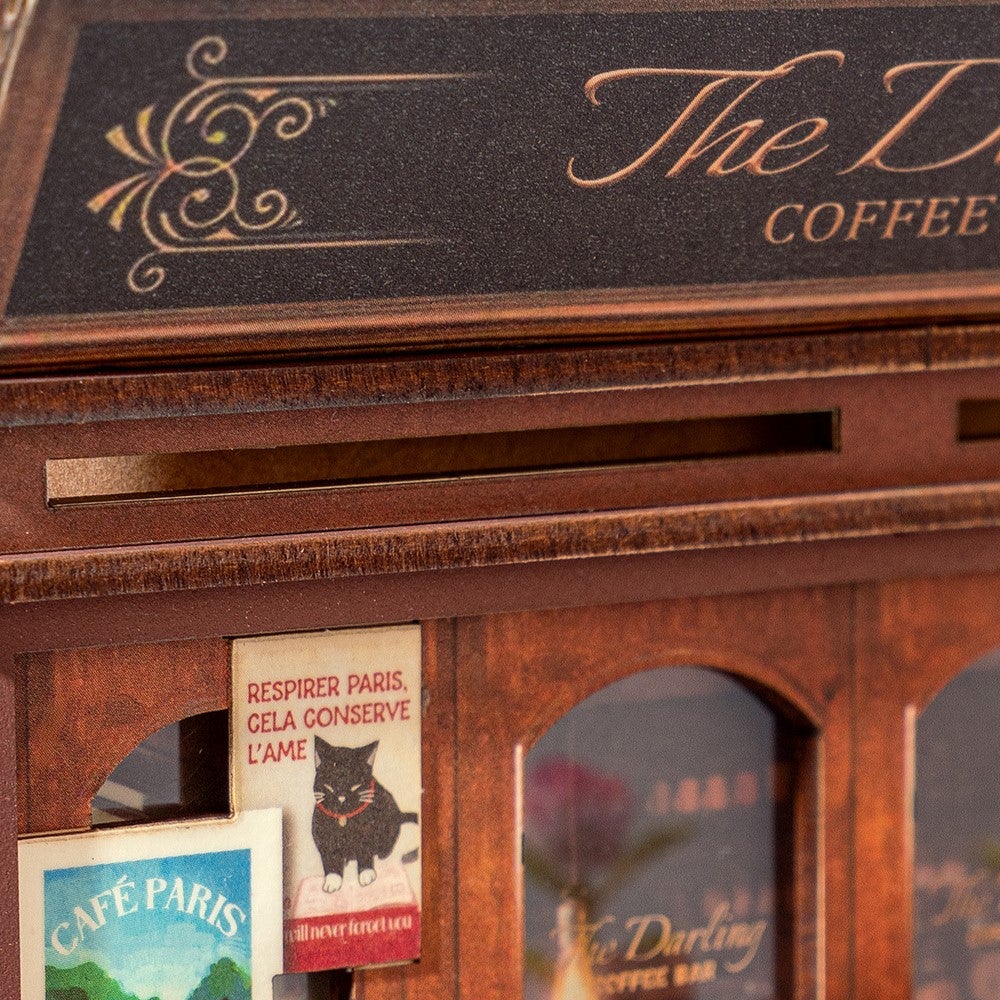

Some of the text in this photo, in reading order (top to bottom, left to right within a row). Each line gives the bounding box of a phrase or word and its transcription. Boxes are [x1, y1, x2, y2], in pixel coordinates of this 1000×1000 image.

[566, 50, 846, 188] The
[763, 195, 998, 244] COFFEE
[247, 675, 341, 704] RESPIRER
[247, 699, 412, 734] CELA CONSERVE
[248, 739, 308, 765] L'AME
[51, 874, 247, 956] CAFÉ PARIS
[625, 902, 768, 973] Darling
